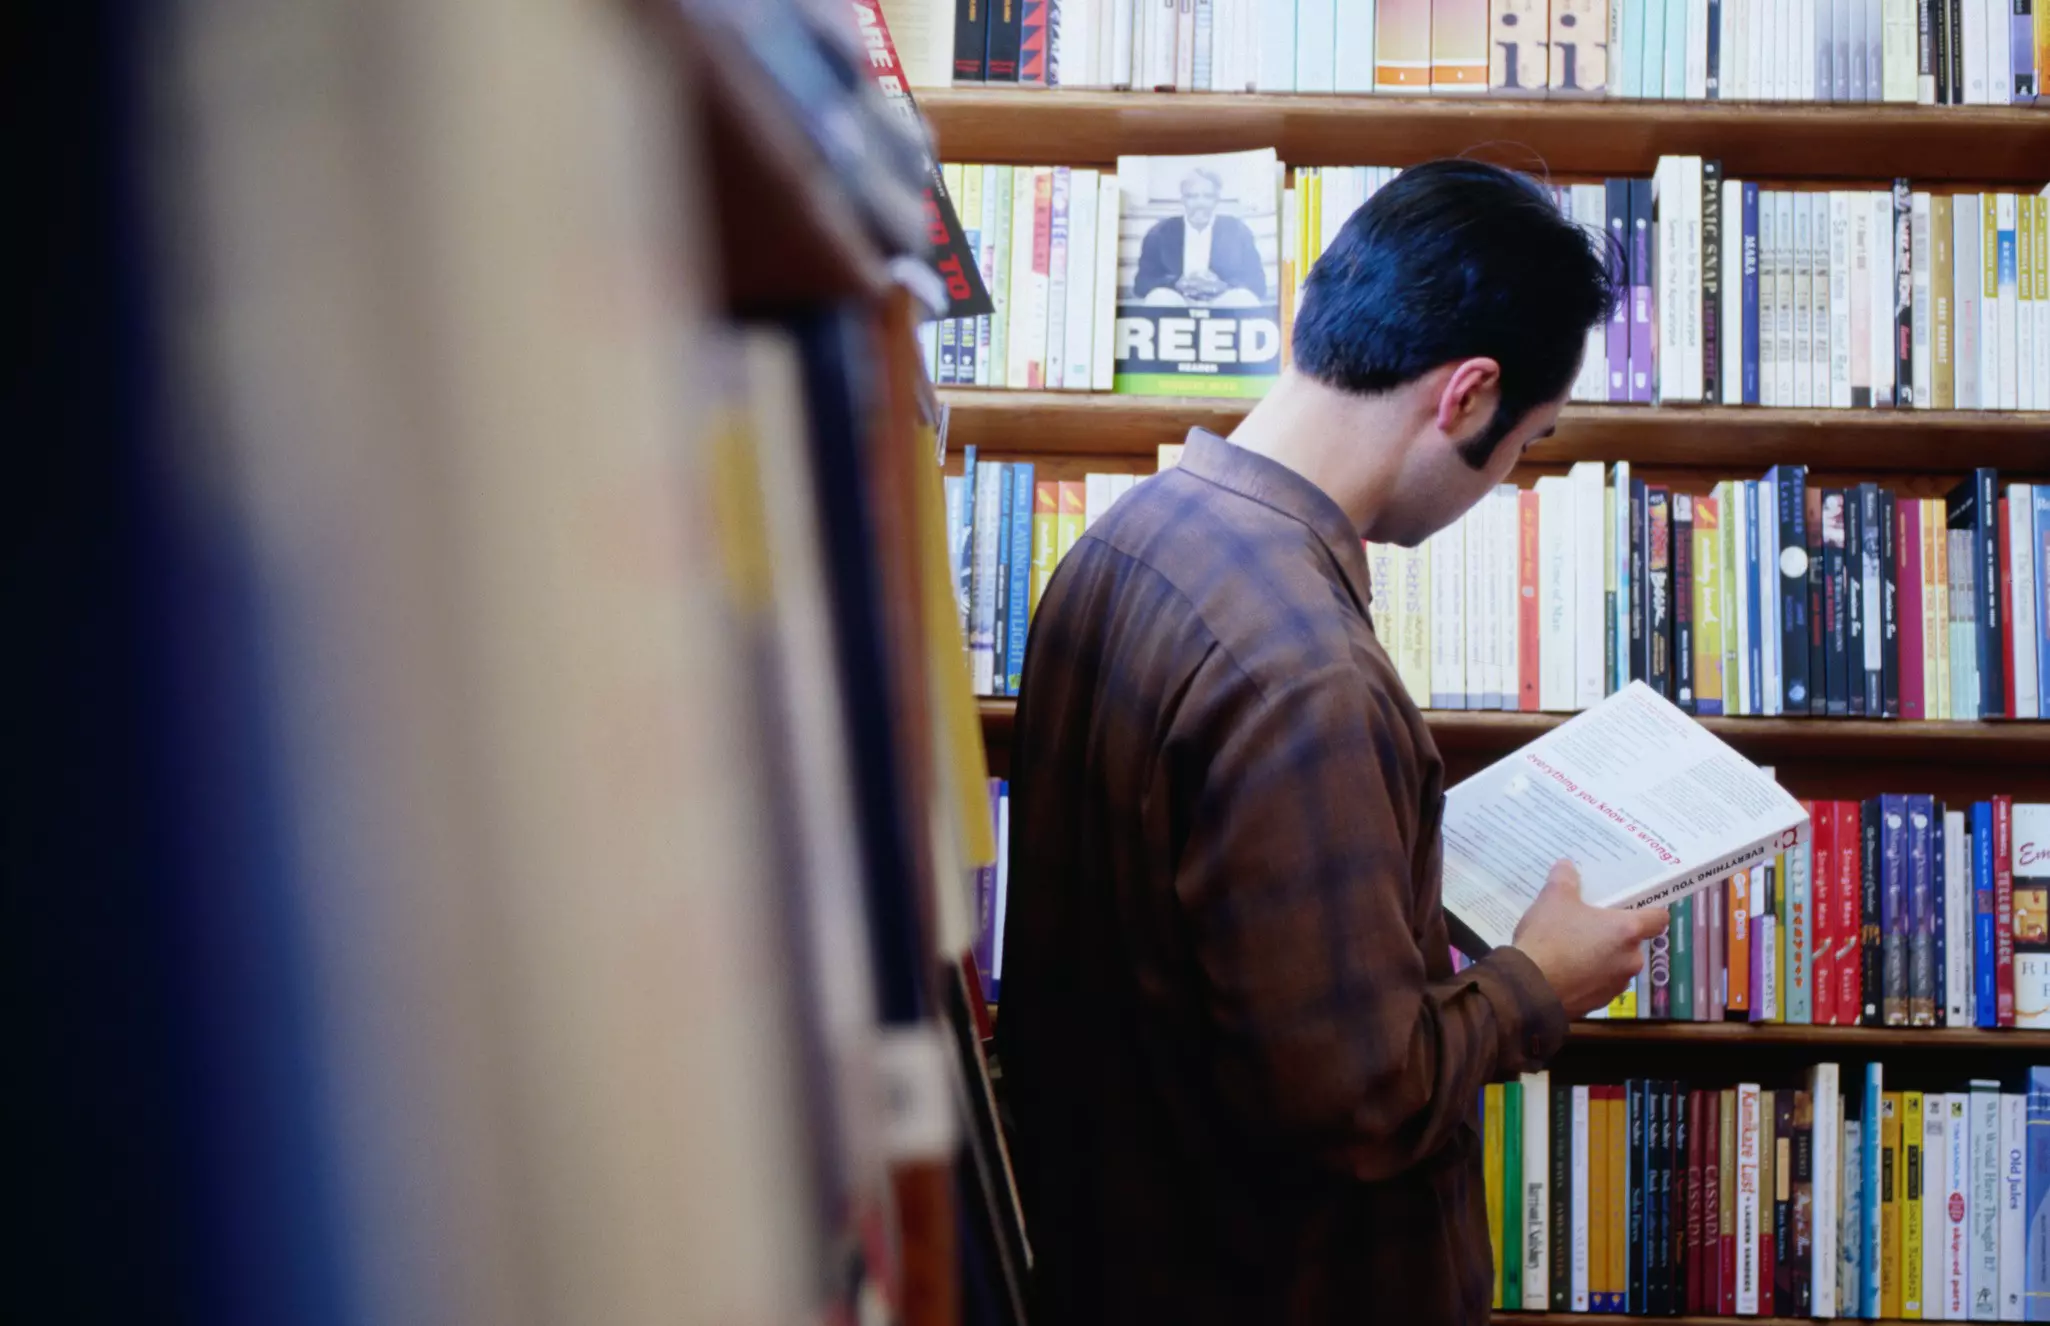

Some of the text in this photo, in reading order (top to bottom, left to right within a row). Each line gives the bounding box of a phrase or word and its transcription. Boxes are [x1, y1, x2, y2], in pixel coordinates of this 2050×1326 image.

[1703, 179, 1718, 237] PANIC
[1703, 244, 1718, 293] SNAP
[1116, 317, 1279, 362] REED
[1013, 512, 1028, 577] PLAYING
[1010, 618, 1025, 665] LIGHT
[1552, 606, 1563, 633] Man
[1526, 753, 1577, 795] everything
[1575, 790, 1597, 804] you
[1597, 802, 1626, 826] know
[1627, 823, 1637, 832] is
[1637, 831, 1682, 866] wrong?
[1636, 846, 1765, 909] EVERYTHING YOU KNOW
[1816, 850, 1828, 898] Straight
[1841, 849, 1853, 896] Straight
[1819, 903, 1828, 928] Man
[1844, 901, 1852, 927] Man
[1998, 871, 2010, 965] YELLOW JACK
[1741, 1091, 1758, 1194] Kamikaze Lust
[1688, 1165, 1700, 1247] CASSADA
[1704, 1164, 1718, 1247] CASSADA
[1981, 1101, 1997, 1272] Who Would Have Thought It?
[2007, 1149, 2022, 1210] Old Jules
[1744, 1204, 1752, 1292] LAUREN SANDERS
[1908, 1203, 1919, 1299] Social Blunders
[1951, 1280, 1961, 1312] parts
